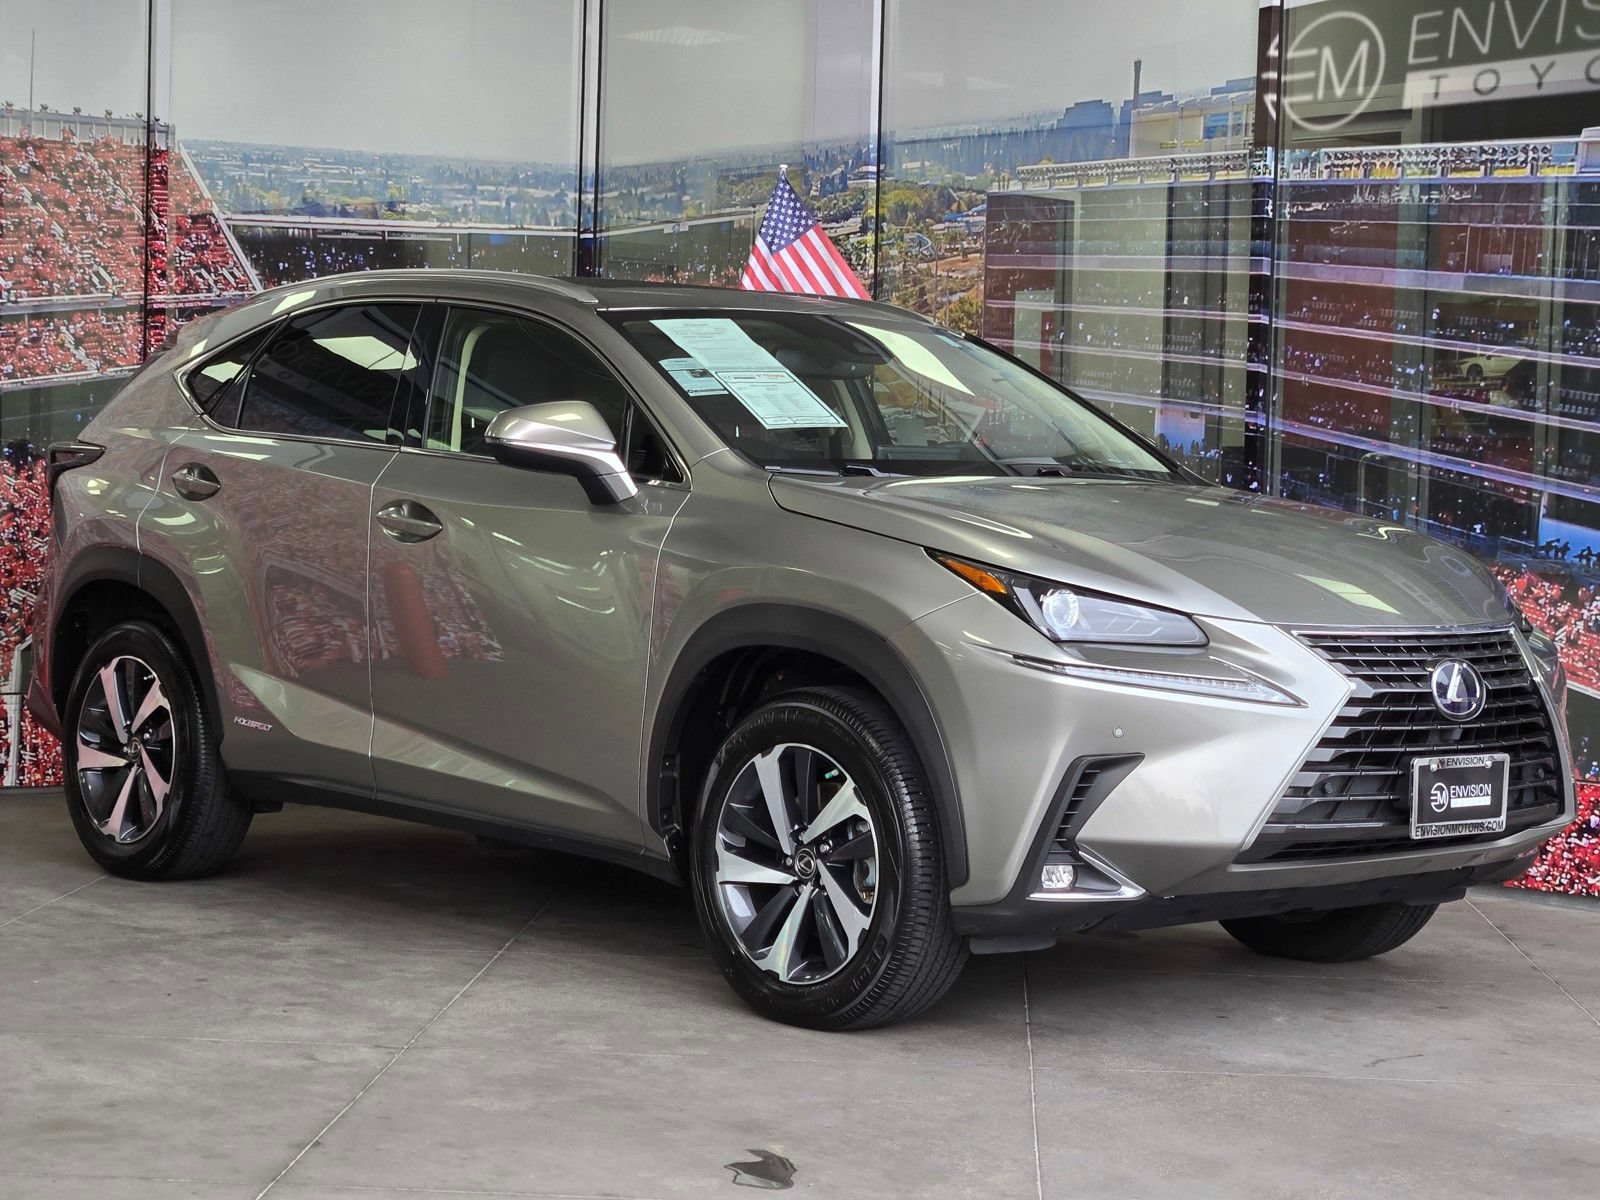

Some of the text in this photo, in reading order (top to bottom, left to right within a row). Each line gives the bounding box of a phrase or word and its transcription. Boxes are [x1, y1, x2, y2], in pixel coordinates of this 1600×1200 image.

[1446, 756, 1485, 767] ENVISION
[1450, 783, 1492, 798] ENVISION
[1415, 820, 1504, 837] ENVISIONMOTORS.COM
